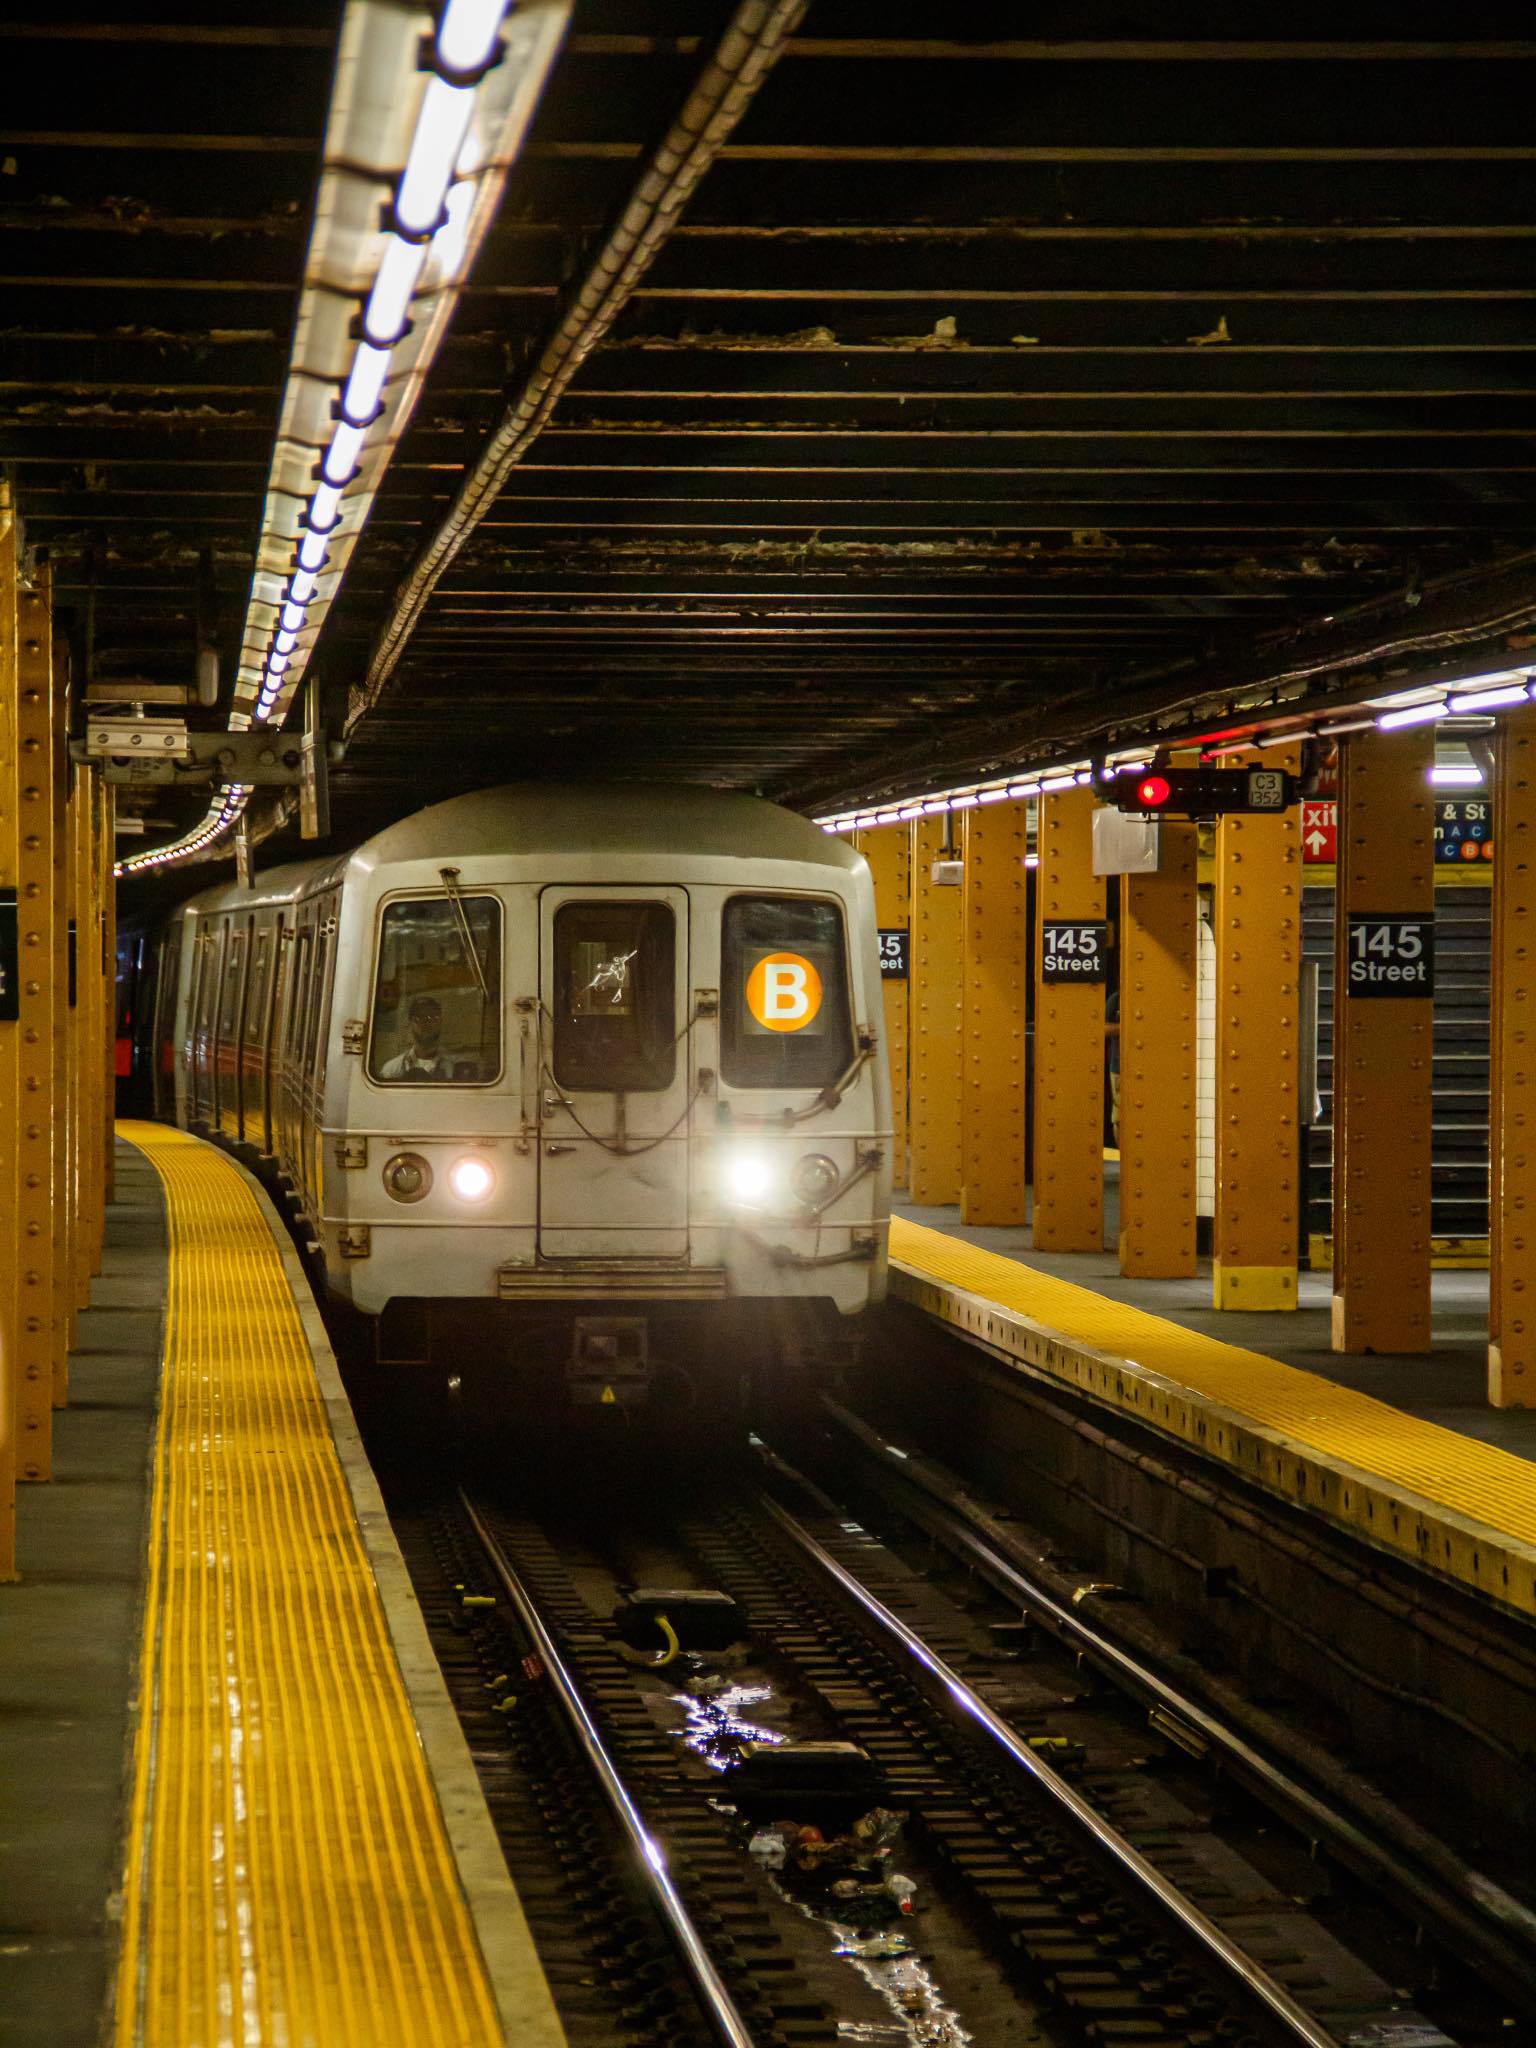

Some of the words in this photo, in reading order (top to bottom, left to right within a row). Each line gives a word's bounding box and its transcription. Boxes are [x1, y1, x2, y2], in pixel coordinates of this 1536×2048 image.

[1256, 775, 1276, 789] C3
[1251, 791, 1281, 804] 1352
[1303, 803, 1337, 826] xit
[1443, 803, 1457, 819] &
[1465, 803, 1486, 820] St
[1451, 826, 1461, 837] A
[1471, 826, 1482, 837] C
[1444, 844, 1455, 856] C
[1044, 929, 1097, 954] 145
[1351, 926, 1422, 958] 145
[880, 957, 903, 969] eet
[1044, 955, 1100, 971] Street
[1351, 961, 1426, 981] Street
[765, 963, 808, 1019] B
